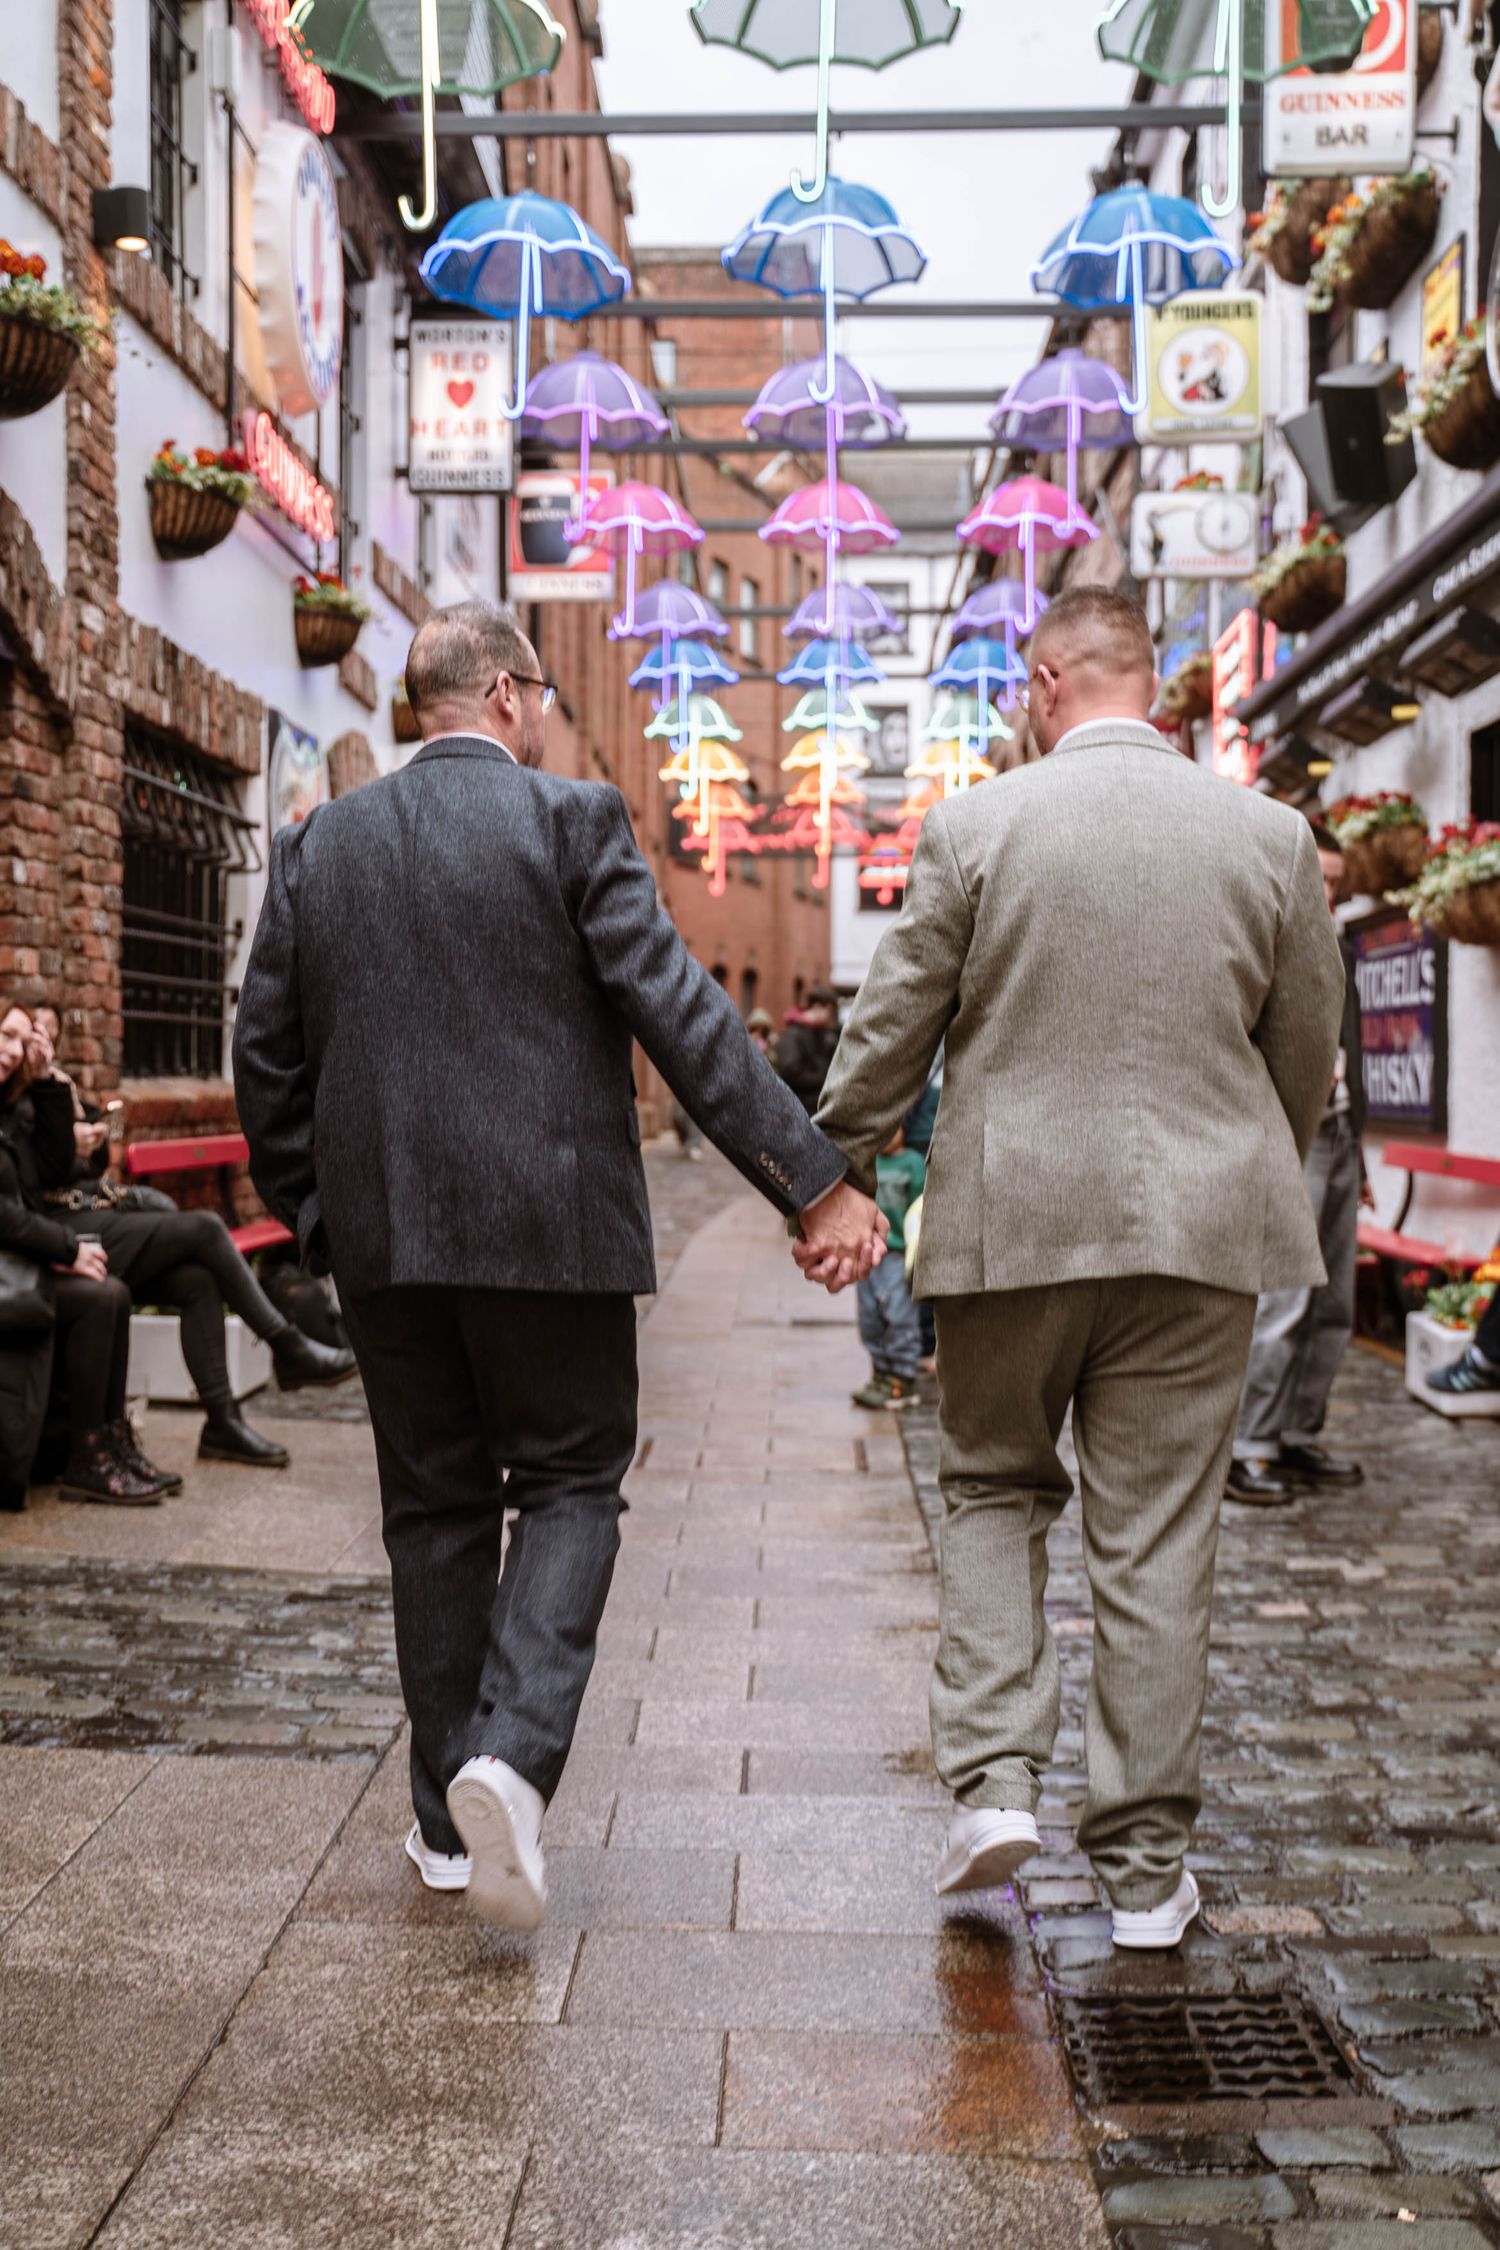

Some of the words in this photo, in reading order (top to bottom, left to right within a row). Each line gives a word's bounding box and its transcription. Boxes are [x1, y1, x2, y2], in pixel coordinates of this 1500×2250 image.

[1279, 90, 1406, 113] GUINNESS
[1315, 124, 1368, 147] BAR
[431, 352, 490, 371] RED
[410, 418, 506, 438] HEART
[413, 469, 506, 484] GUINNESS
[1363, 1052, 1434, 1105] HISKY
